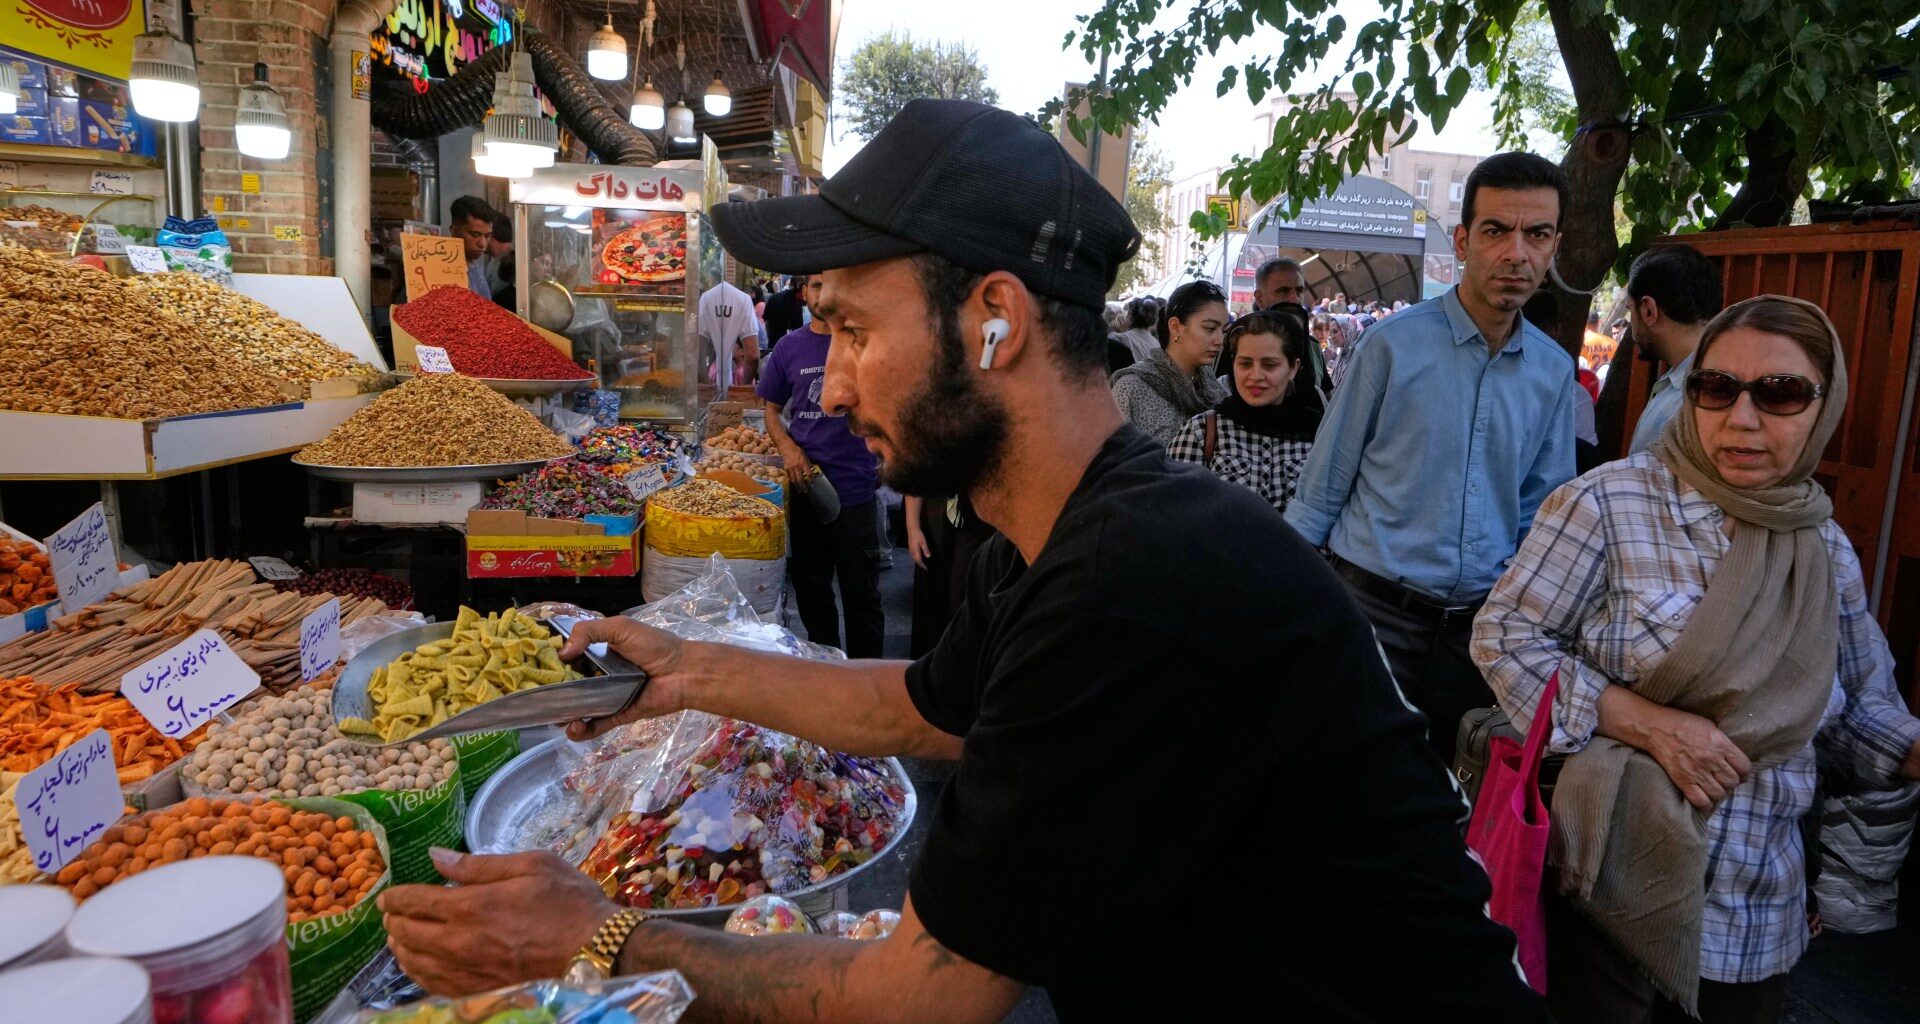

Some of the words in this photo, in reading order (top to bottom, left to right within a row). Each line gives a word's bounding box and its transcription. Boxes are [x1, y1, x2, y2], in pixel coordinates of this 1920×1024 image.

[576, 173, 628, 199] داگ
[636, 176, 685, 200] هات
[1376, 198, 1394, 207] خرداد
[1395, 198, 1414, 209] پانزده
[1319, 220, 1338, 228] مسجد
[1364, 224, 1382, 232] شرقی
[1383, 225, 1403, 234] ورودی
[426, 240, 459, 263] زرشک
[199, 638, 221, 665] بادام
[179, 651, 199, 677] زمینی
[65, 752, 83, 785] زمینی
[83, 738, 107, 780] بادام
